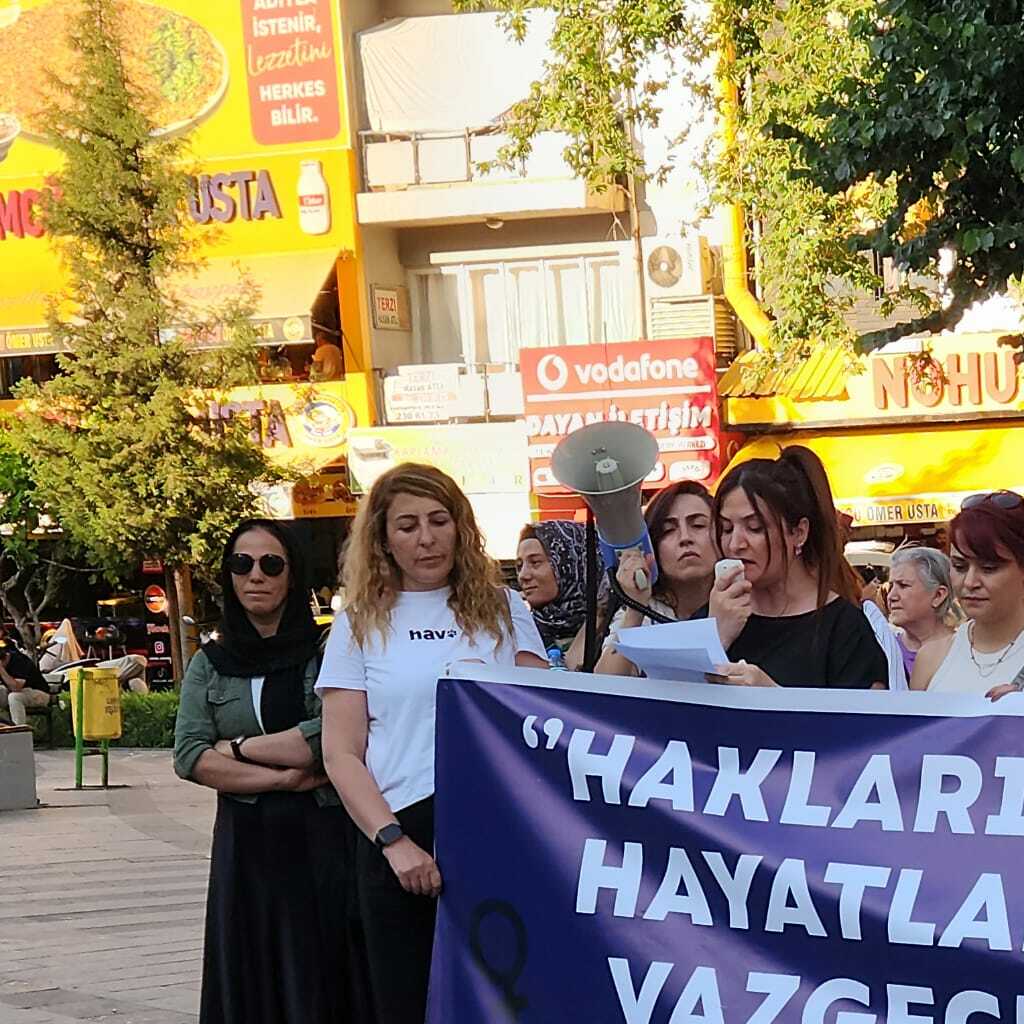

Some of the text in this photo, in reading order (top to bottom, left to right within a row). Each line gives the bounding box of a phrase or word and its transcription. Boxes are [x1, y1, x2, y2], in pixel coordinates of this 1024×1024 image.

[259, 79, 325, 102] HERKES
[271, 103, 319, 126] BİLİR.
[187, 169, 282, 226] USTA
[574, 353, 699, 384] vodafone
[907, 503, 938, 519] USTA
